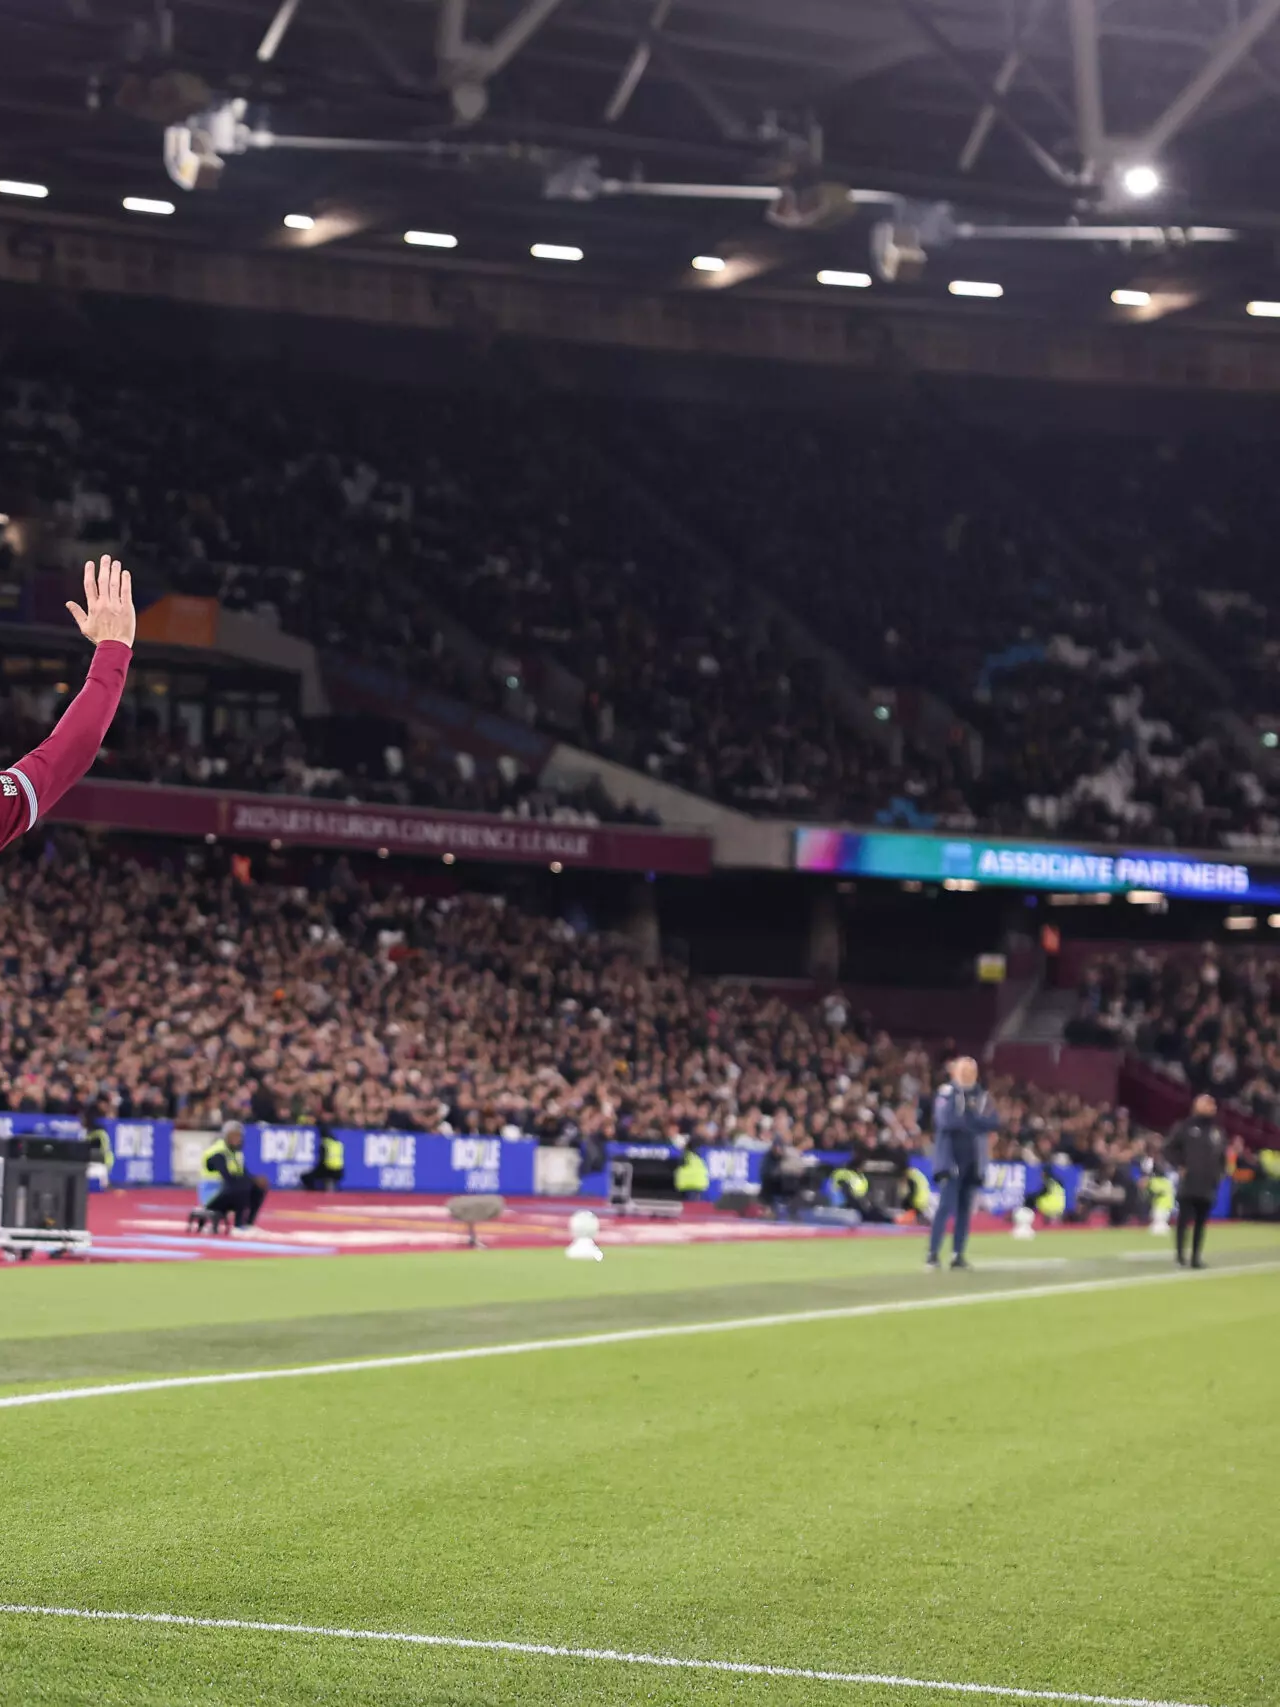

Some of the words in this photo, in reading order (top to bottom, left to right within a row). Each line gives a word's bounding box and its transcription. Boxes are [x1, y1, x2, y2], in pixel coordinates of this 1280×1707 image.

[978, 847, 1115, 885] ASSOCIATE
[1117, 857, 1251, 894] PARTNERS
[260, 1129, 316, 1163] BOYLE
[364, 1134, 416, 1168] BOYLE
[451, 1137, 501, 1171] BOYLE
